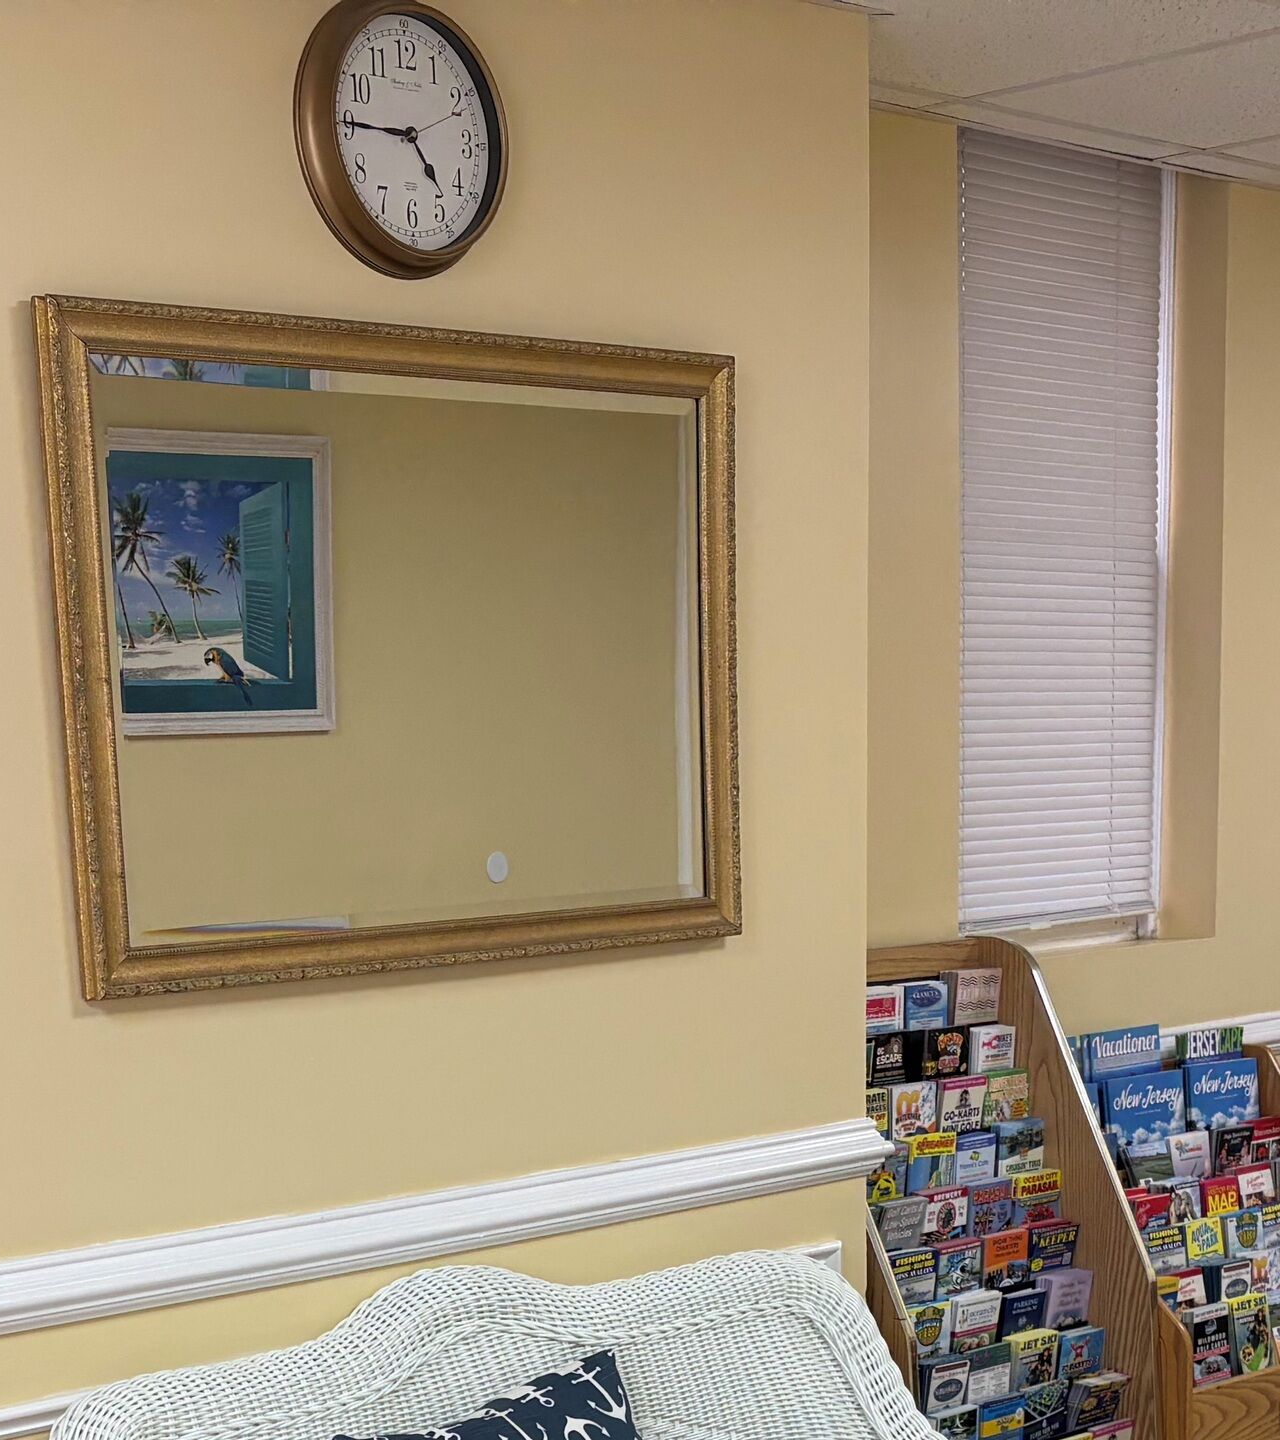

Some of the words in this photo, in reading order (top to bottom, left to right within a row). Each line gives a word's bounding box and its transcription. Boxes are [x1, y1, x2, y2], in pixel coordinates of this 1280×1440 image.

[368, 46, 387, 79] 11
[393, 38, 417, 71] 12
[428, 55, 439, 86] 1
[350, 72, 370, 105] 10
[450, 87, 462, 117] 2
[342, 109, 355, 141] 9
[461, 129, 473, 160] 3
[354, 152, 367, 184] 8
[451, 167, 464, 197] 4
[376, 185, 388, 216] 7
[406, 198, 418, 229] 6
[434, 194, 445, 224] 5
[876, 1053, 903, 1065] ESCAPE
[1092, 1031, 1158, 1058] Vacationer
[1113, 1083, 1142, 1111] New
[1141, 1085, 1180, 1111] Jersey
[1193, 1069, 1221, 1096] New
[1220, 1070, 1255, 1097] Jersey
[943, 1106, 980, 1122] GO-KARTS
[1207, 1192, 1237, 1213] MAP
[1148, 1227, 1180, 1241] FISHING
[896, 1252, 932, 1267] FISHING
[1234, 1300, 1252, 1311] JET
[1021, 1338, 1040, 1351] JET
[1041, 1333, 1057, 1346] SKI
